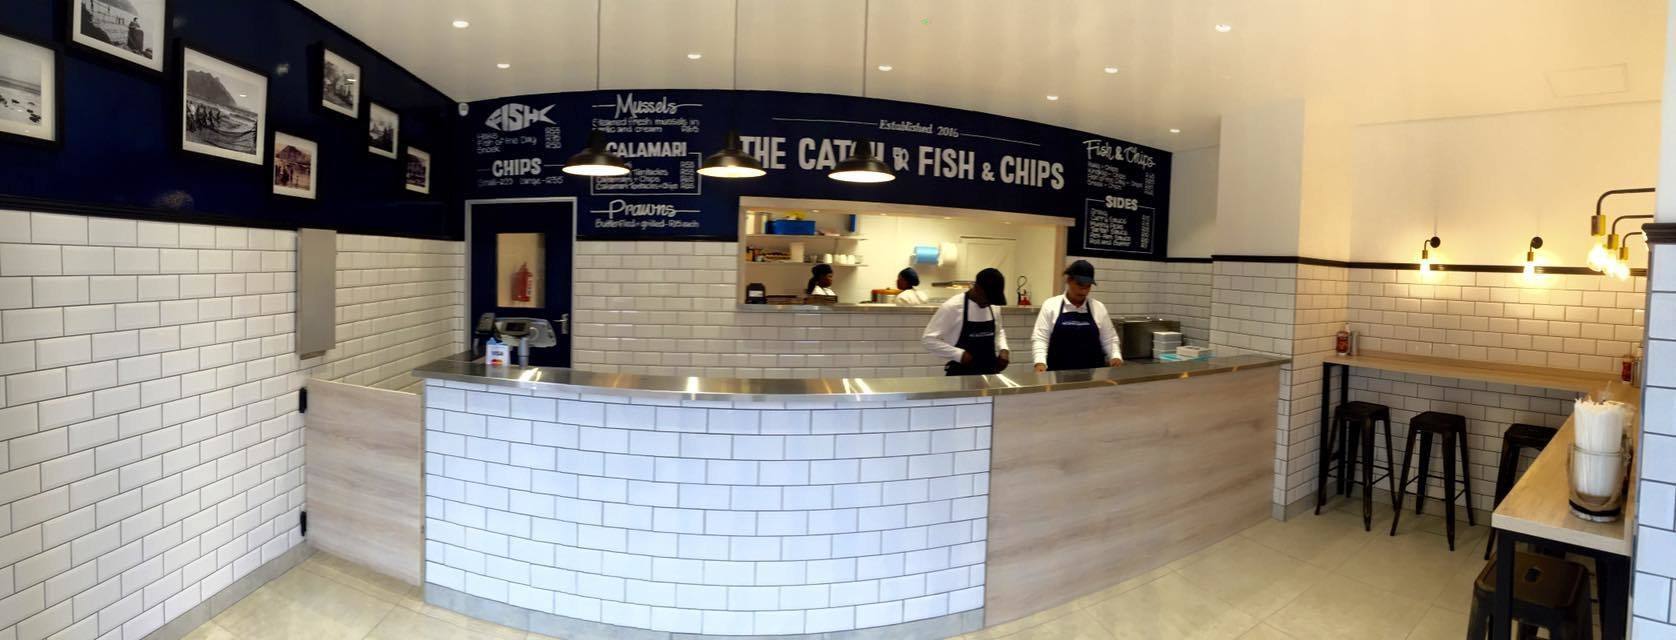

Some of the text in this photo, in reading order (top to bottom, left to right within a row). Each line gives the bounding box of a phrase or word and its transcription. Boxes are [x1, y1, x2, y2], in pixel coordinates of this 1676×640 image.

[614, 93, 678, 119] Mussels
[879, 119, 960, 138] Established 2016
[605, 141, 687, 158] CALAMARI
[1082, 139, 1114, 161] Fish
[1114, 145, 1125, 161] &
[492, 157, 542, 178] CHIPS
[739, 135, 1065, 190] THE CATH FISH & CHIPS
[609, 199, 677, 219] Prawns
[1105, 195, 1138, 211] SIDES
